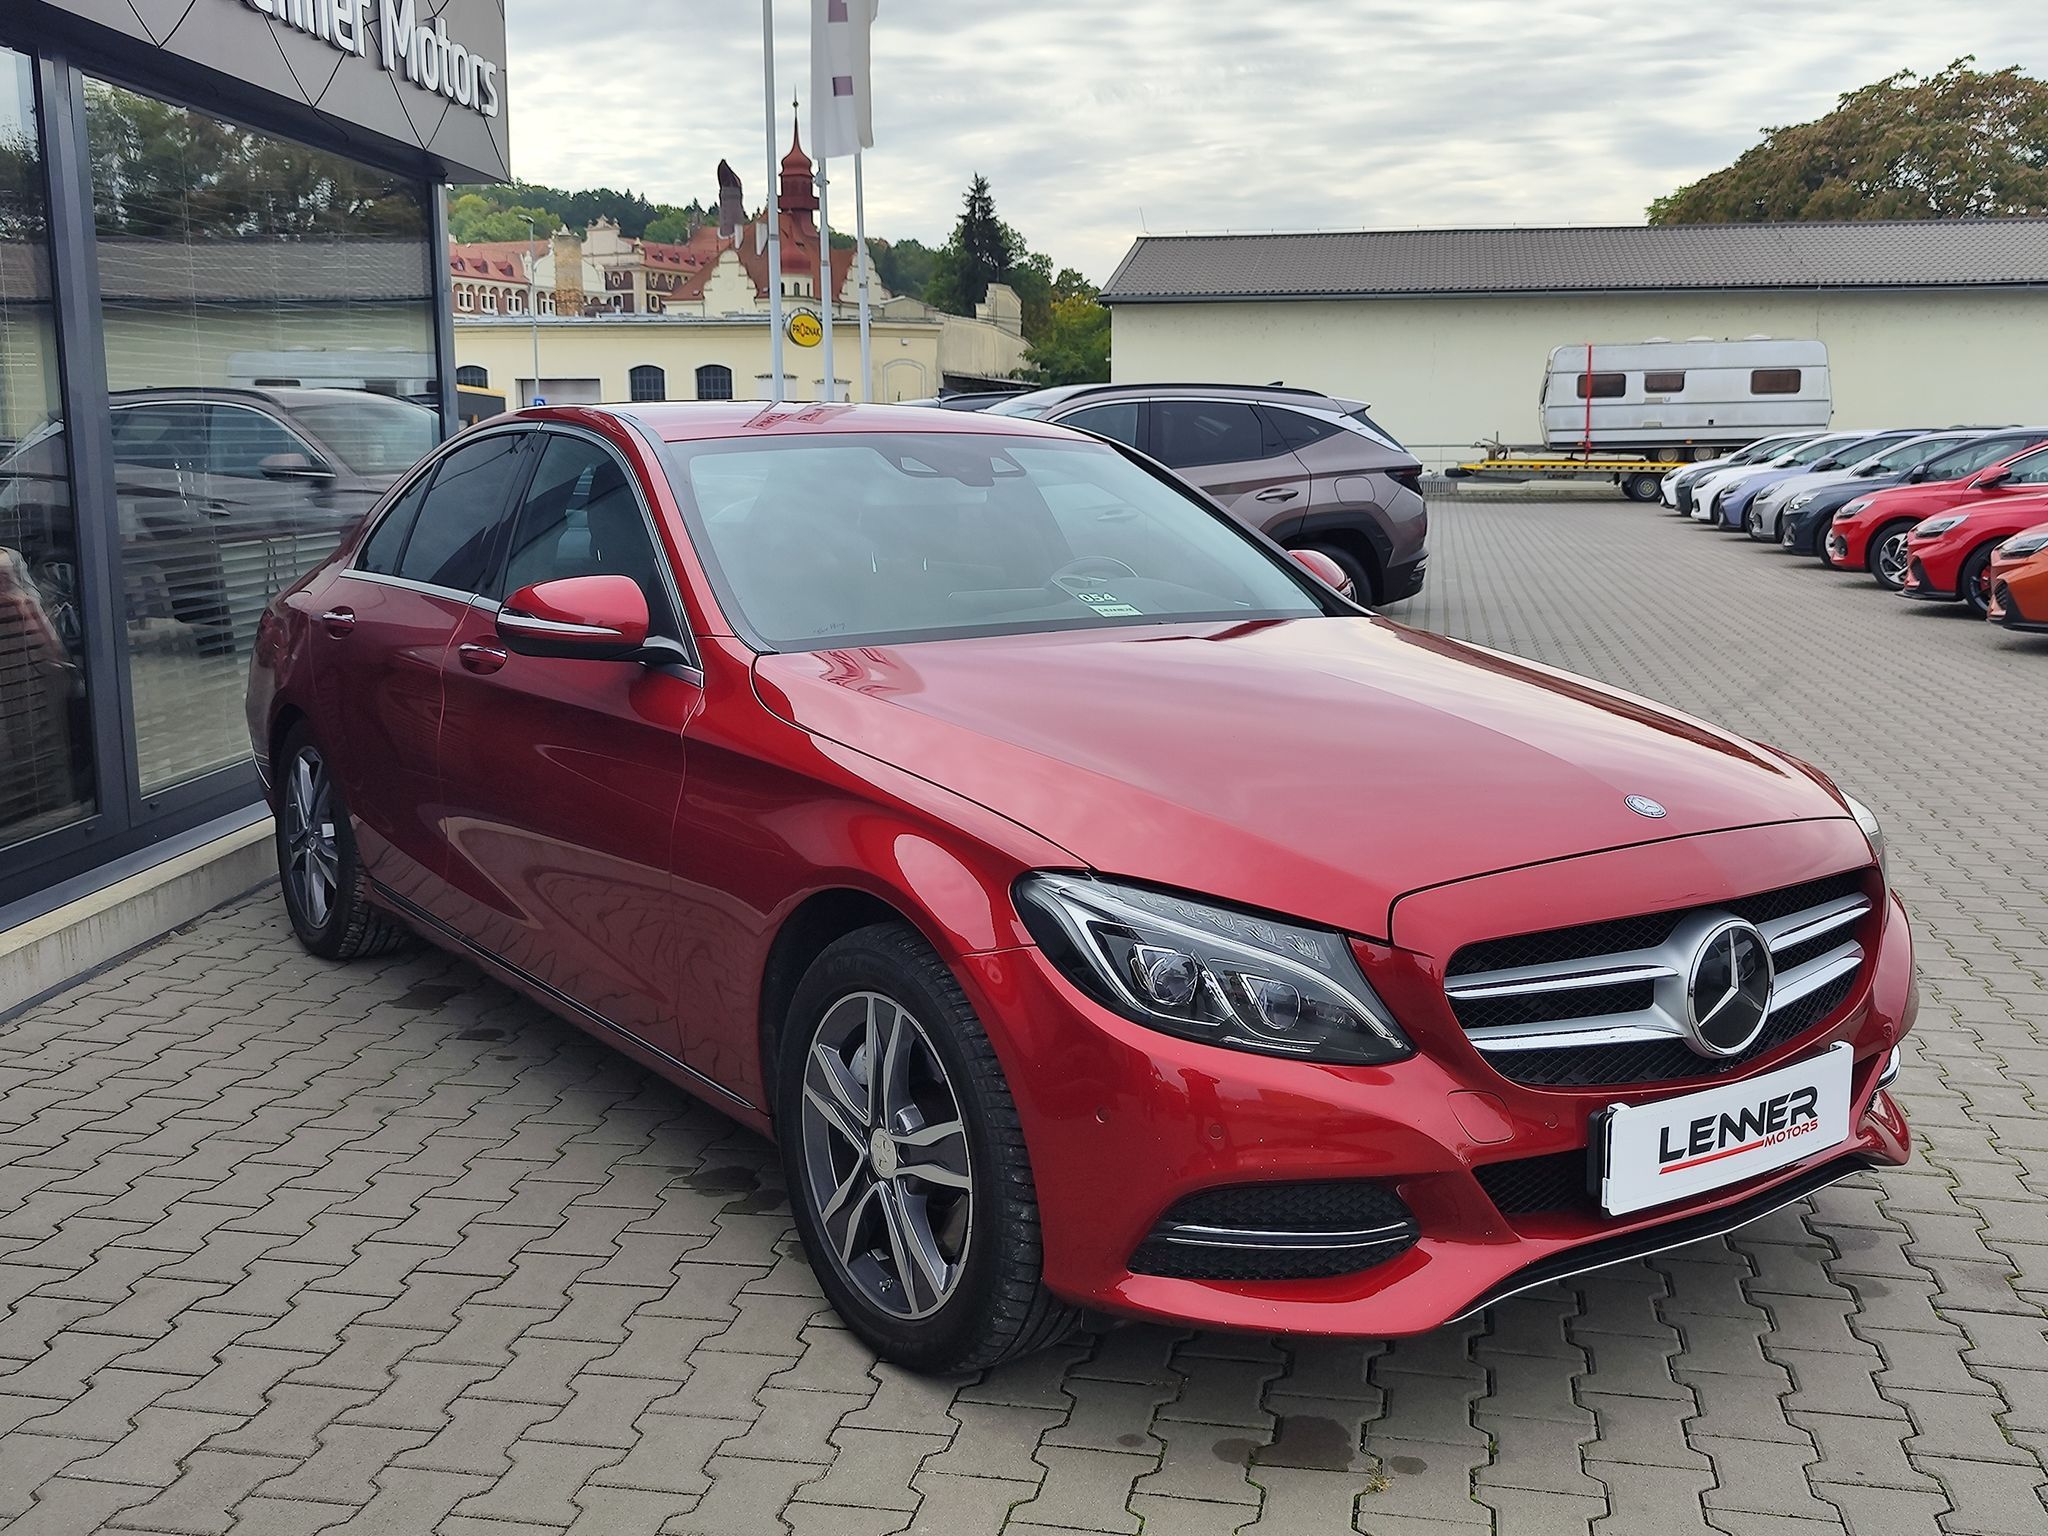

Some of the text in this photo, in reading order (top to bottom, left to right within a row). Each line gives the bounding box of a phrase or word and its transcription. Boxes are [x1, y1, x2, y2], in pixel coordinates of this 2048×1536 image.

[379, 0, 499, 117] Motors
[1078, 592, 1116, 602] 054
[1659, 1086, 1818, 1163] LENNER
[1765, 1119, 1818, 1148] MOTORS
